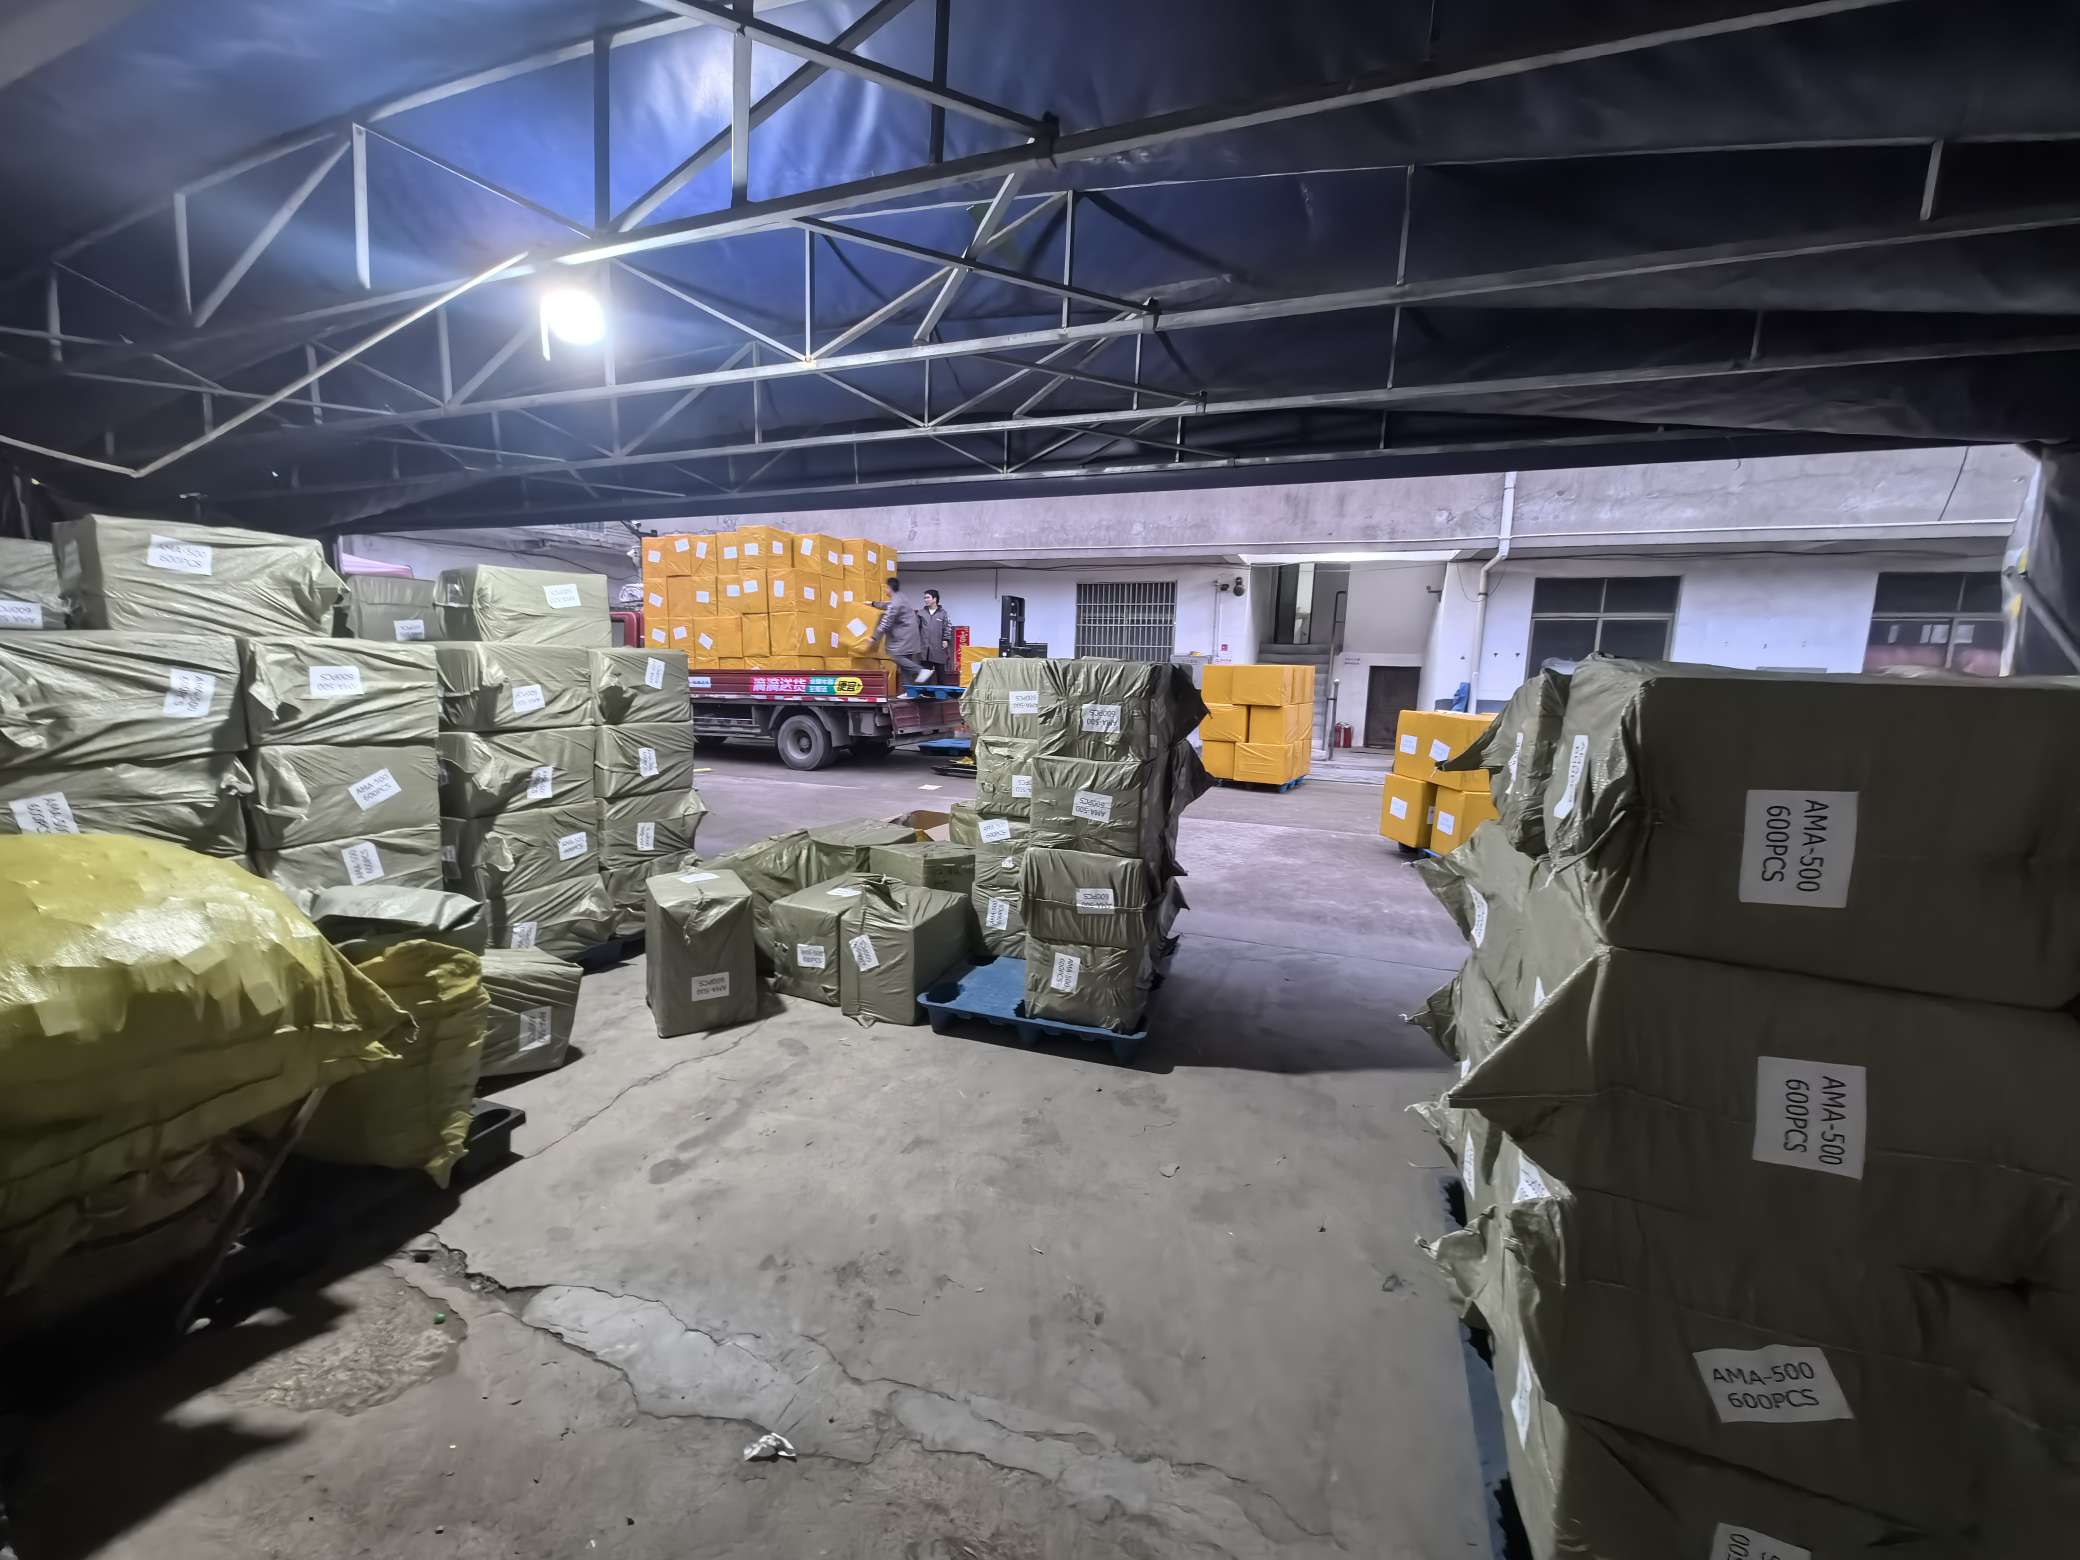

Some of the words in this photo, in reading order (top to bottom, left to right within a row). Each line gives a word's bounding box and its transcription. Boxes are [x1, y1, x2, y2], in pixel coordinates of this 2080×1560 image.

[1086, 717, 1117, 727] AMA-500
[1089, 709, 1116, 718] 600PCS
[1076, 805, 1107, 817] AMA-500
[1079, 797, 1106, 808] 600PCS
[1762, 805, 1791, 882] 600PCS
[1796, 799, 1829, 892] AMA-500
[1783, 1078, 1809, 1153] 600PCS
[1818, 1075, 1847, 1165] AMA-500
[1712, 1361, 1816, 1385] AMA-500
[1727, 1389, 1820, 1410] 600PCS
